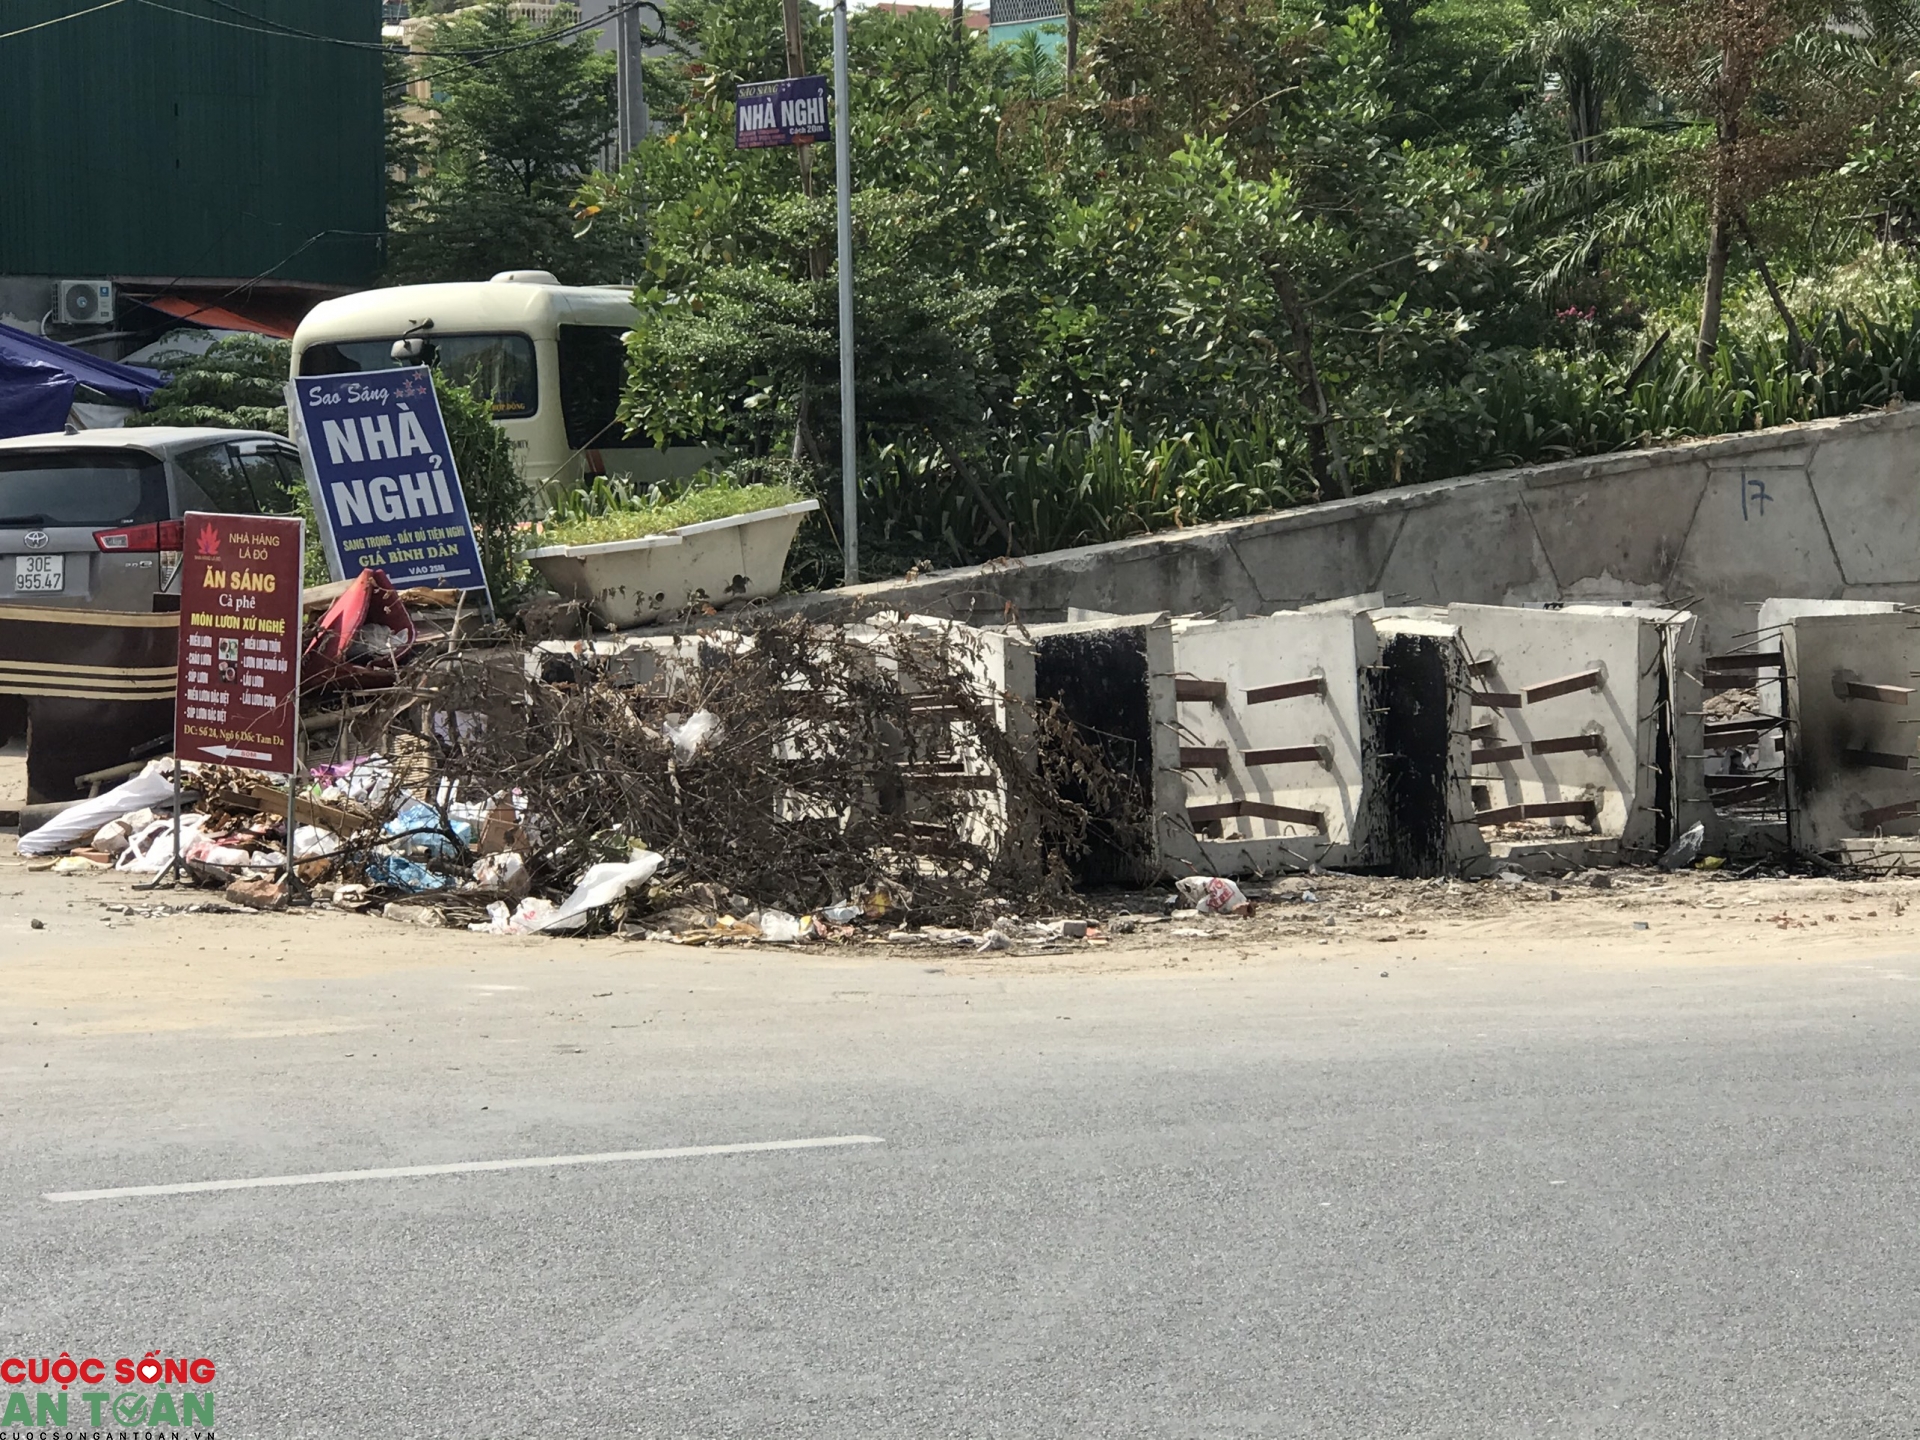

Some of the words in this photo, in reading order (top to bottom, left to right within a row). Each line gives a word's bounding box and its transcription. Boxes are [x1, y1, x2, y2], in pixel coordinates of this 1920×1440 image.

[739, 97, 776, 131] NHÀ
[781, 88, 825, 127] NGHỈ
[309, 386, 341, 406] Sao
[347, 383, 389, 406] Sáng
[322, 402, 433, 464] NHÀ
[330, 454, 454, 527] NGHỈ
[229, 532, 250, 544] NHÀ
[252, 533, 280, 547] HÀNG
[343, 538, 365, 551] SANG
[365, 534, 392, 549] TRỌNG
[414, 527, 426, 542] ĐỦ
[426, 526, 445, 542] TIỆN
[445, 525, 465, 538] NGHI
[26, 557, 52, 572] 30E
[239, 547, 251, 559] LÁ
[253, 548, 268, 560] ĐỎ
[359, 550, 386, 567] GIÁ
[388, 548, 424, 563] BÌNH
[427, 543, 459, 558] DÂN
[16, 573, 61, 589] 955.47
[203, 565, 226, 588] ĂN
[230, 568, 276, 593] SÁNG
[219, 594, 233, 608] Cà
[235, 595, 256, 612] phê
[191, 611, 213, 627] MÓN
[215, 615, 240, 629] LƯƠN
[242, 615, 258, 630] XỨ
[258, 618, 285, 636] NGHỆ
[235, 731, 240, 740] 6
[256, 733, 272, 745] Tam
